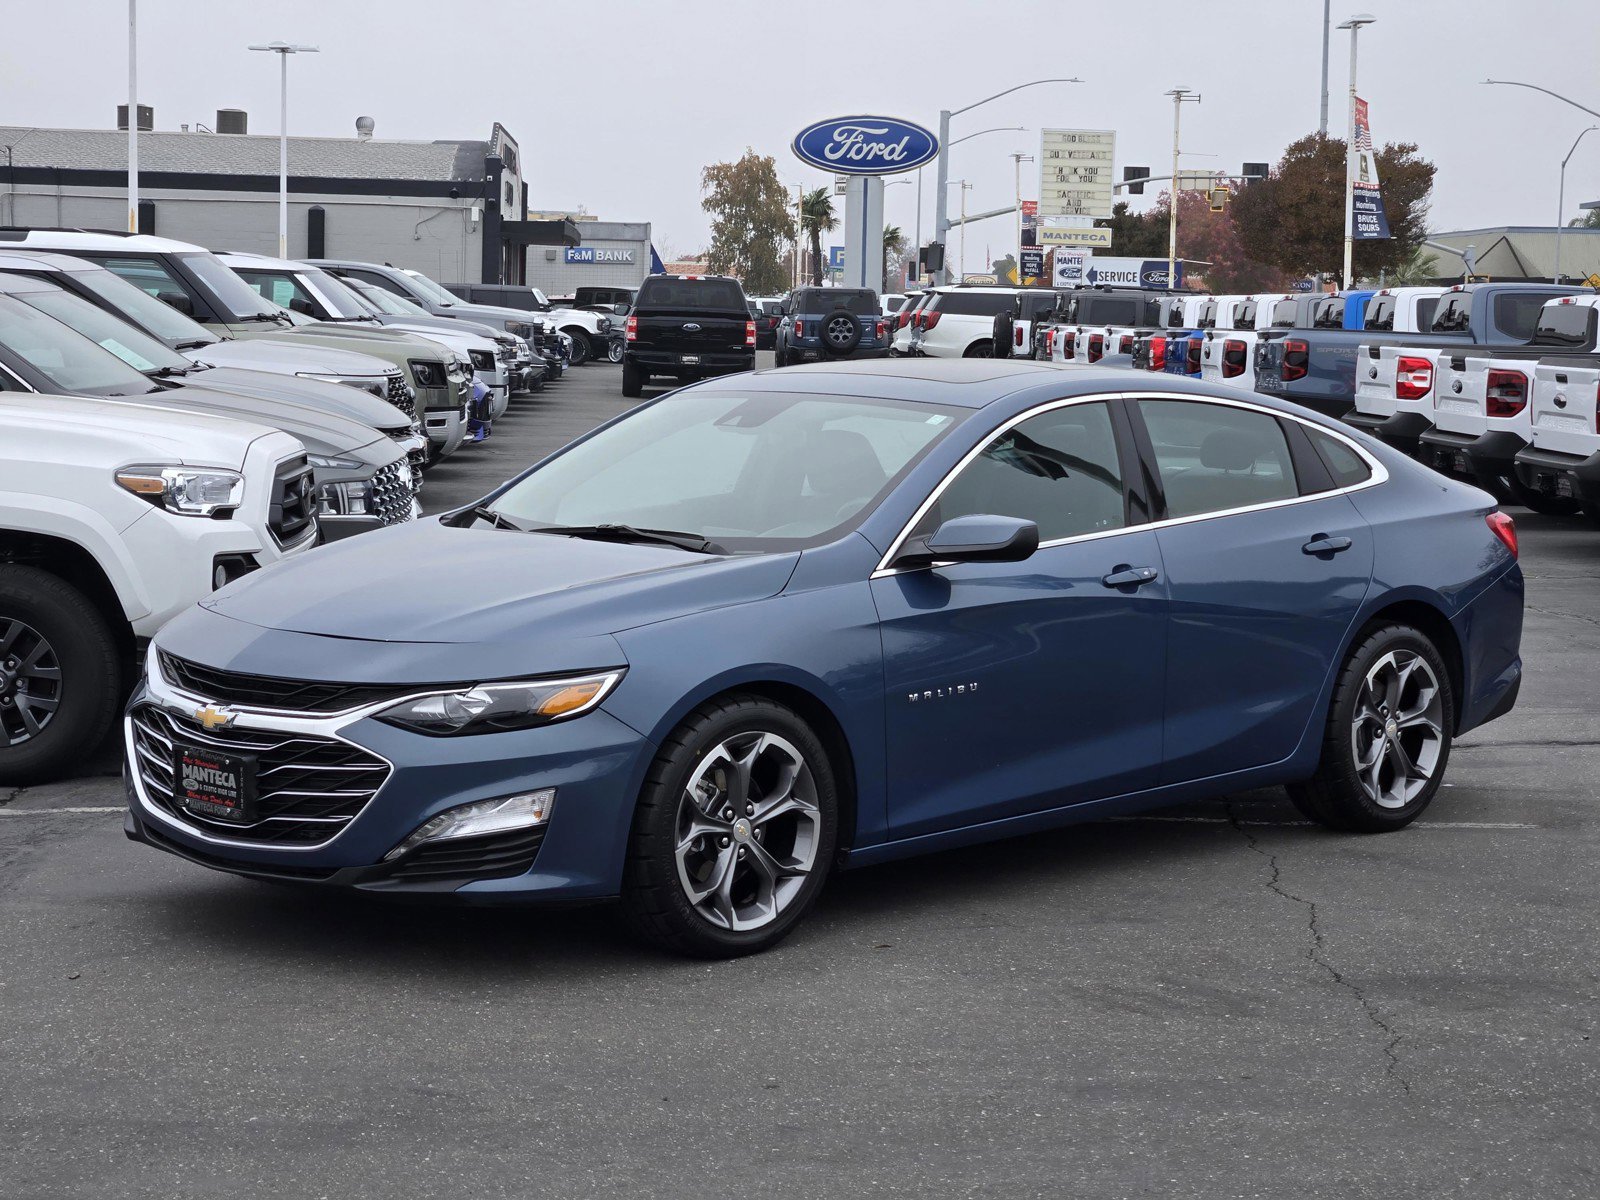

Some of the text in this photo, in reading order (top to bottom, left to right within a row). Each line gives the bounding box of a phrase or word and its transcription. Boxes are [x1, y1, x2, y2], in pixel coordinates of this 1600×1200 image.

[824, 126, 910, 161] Ford
[1084, 167, 1098, 175] YOU
[1357, 215, 1378, 223] BRUCE
[1358, 224, 1380, 232] SOURS
[1043, 232, 1107, 241] MANTECA
[567, 250, 632, 261] F&M BANK
[1057, 256, 1082, 265] MANTE
[1098, 271, 1137, 283] SERVICE
[908, 682, 978, 702] MALIBU
[182, 763, 237, 789] MANTECA
